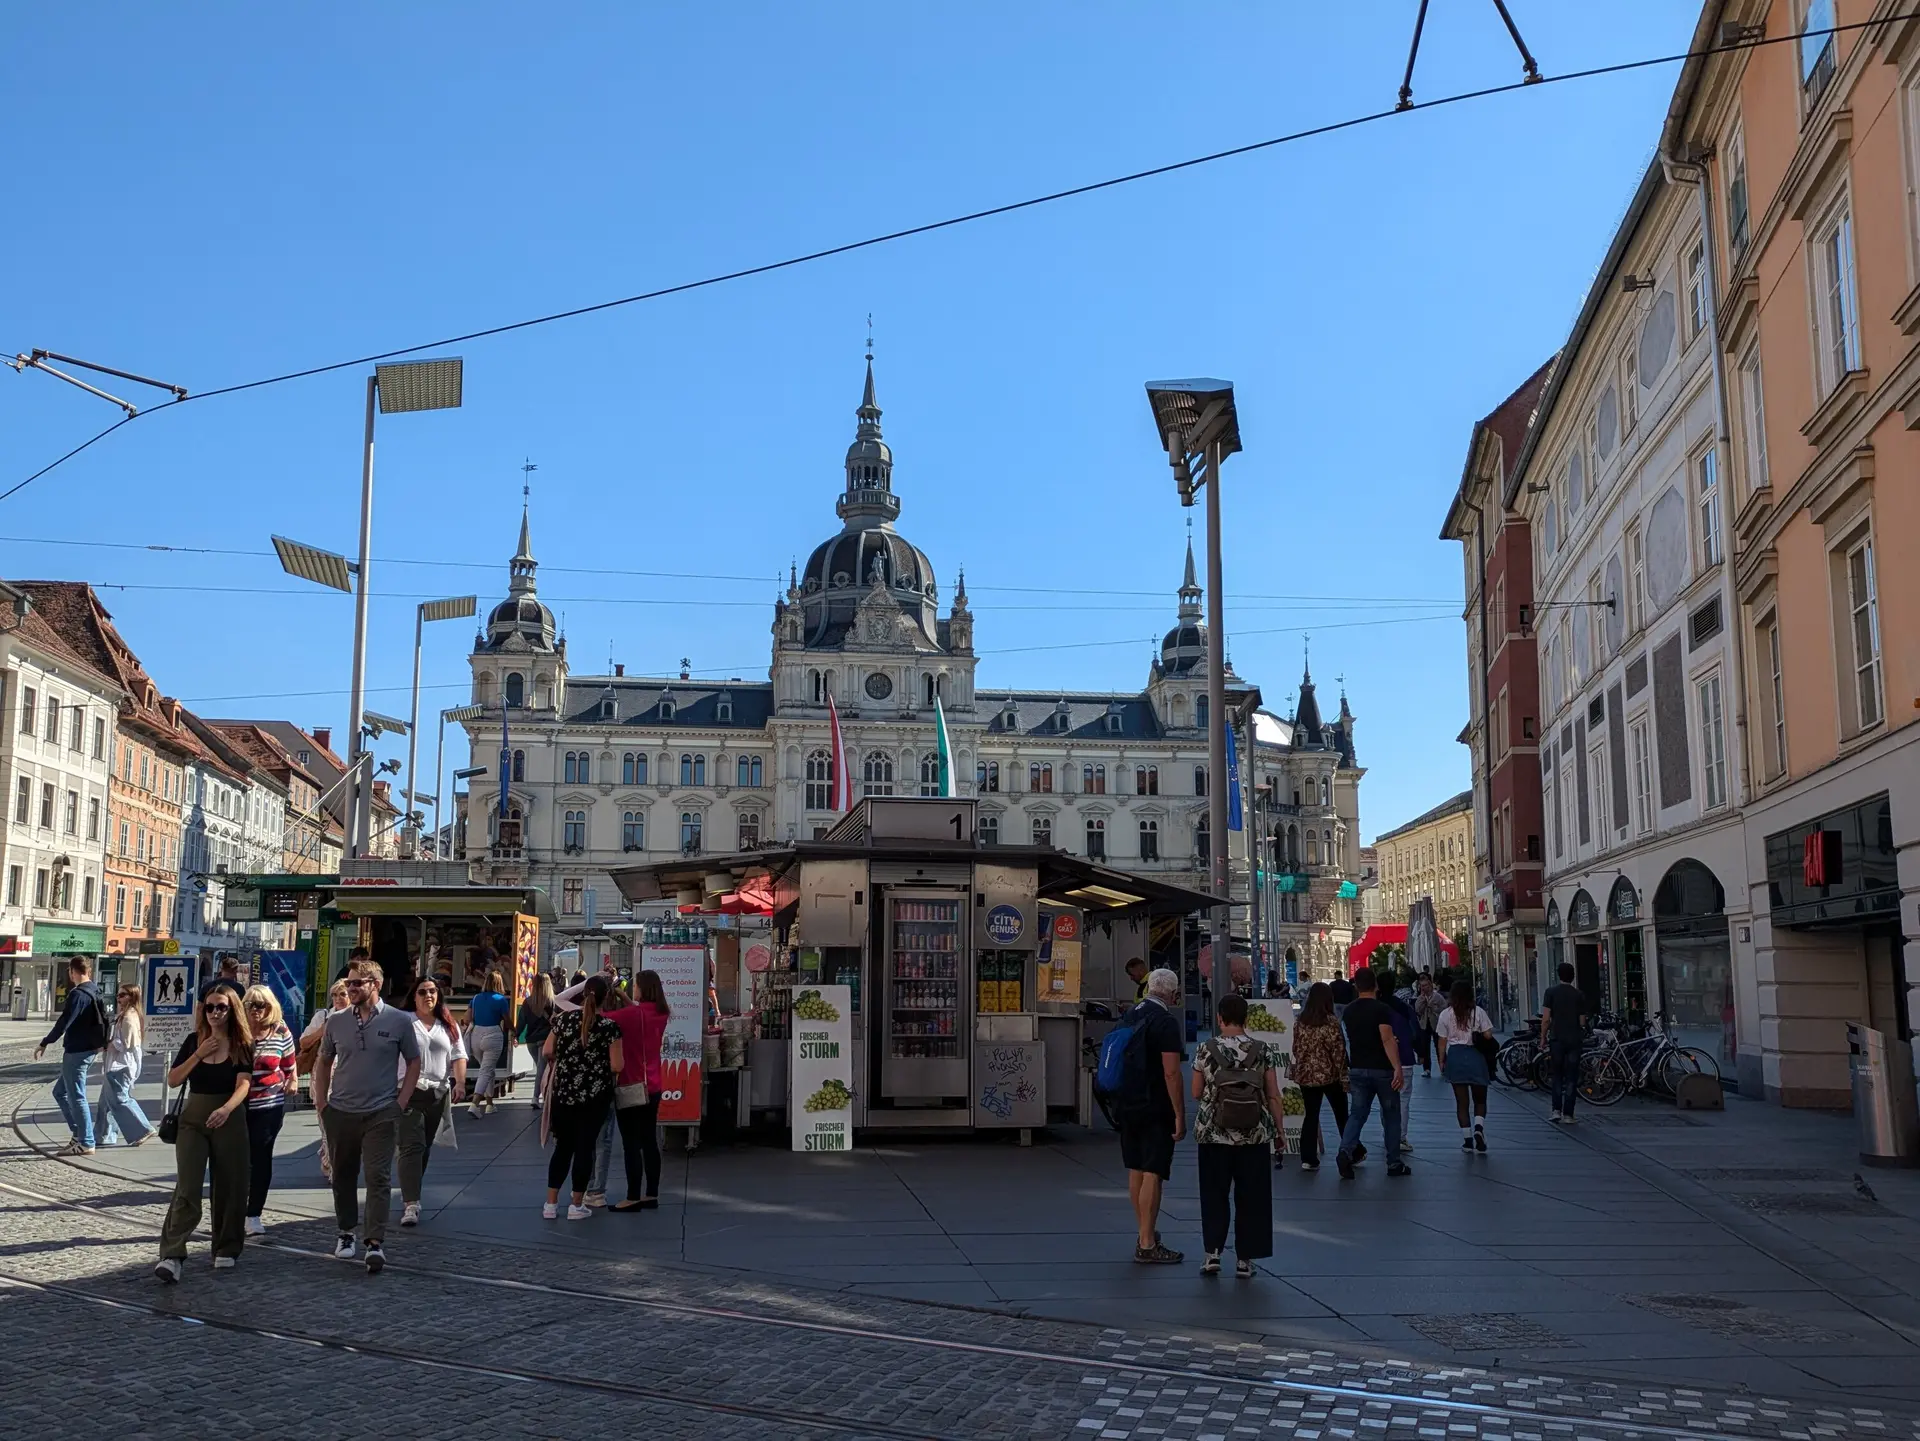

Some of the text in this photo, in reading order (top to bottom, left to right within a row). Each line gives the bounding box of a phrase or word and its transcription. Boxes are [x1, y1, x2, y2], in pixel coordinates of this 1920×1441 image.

[950, 814, 961, 840] 1
[664, 910, 671, 920] 8
[994, 913, 1015, 925] CITY
[759, 918, 771, 927] 14
[990, 925, 1019, 934] GENUSS
[61, 940, 84, 948] PALMERS
[799, 1032, 829, 1041] FRISCHER
[800, 1042, 840, 1059] STURM
[815, 1123, 845, 1132] FRISCHER
[805, 1133, 845, 1151] STURM
